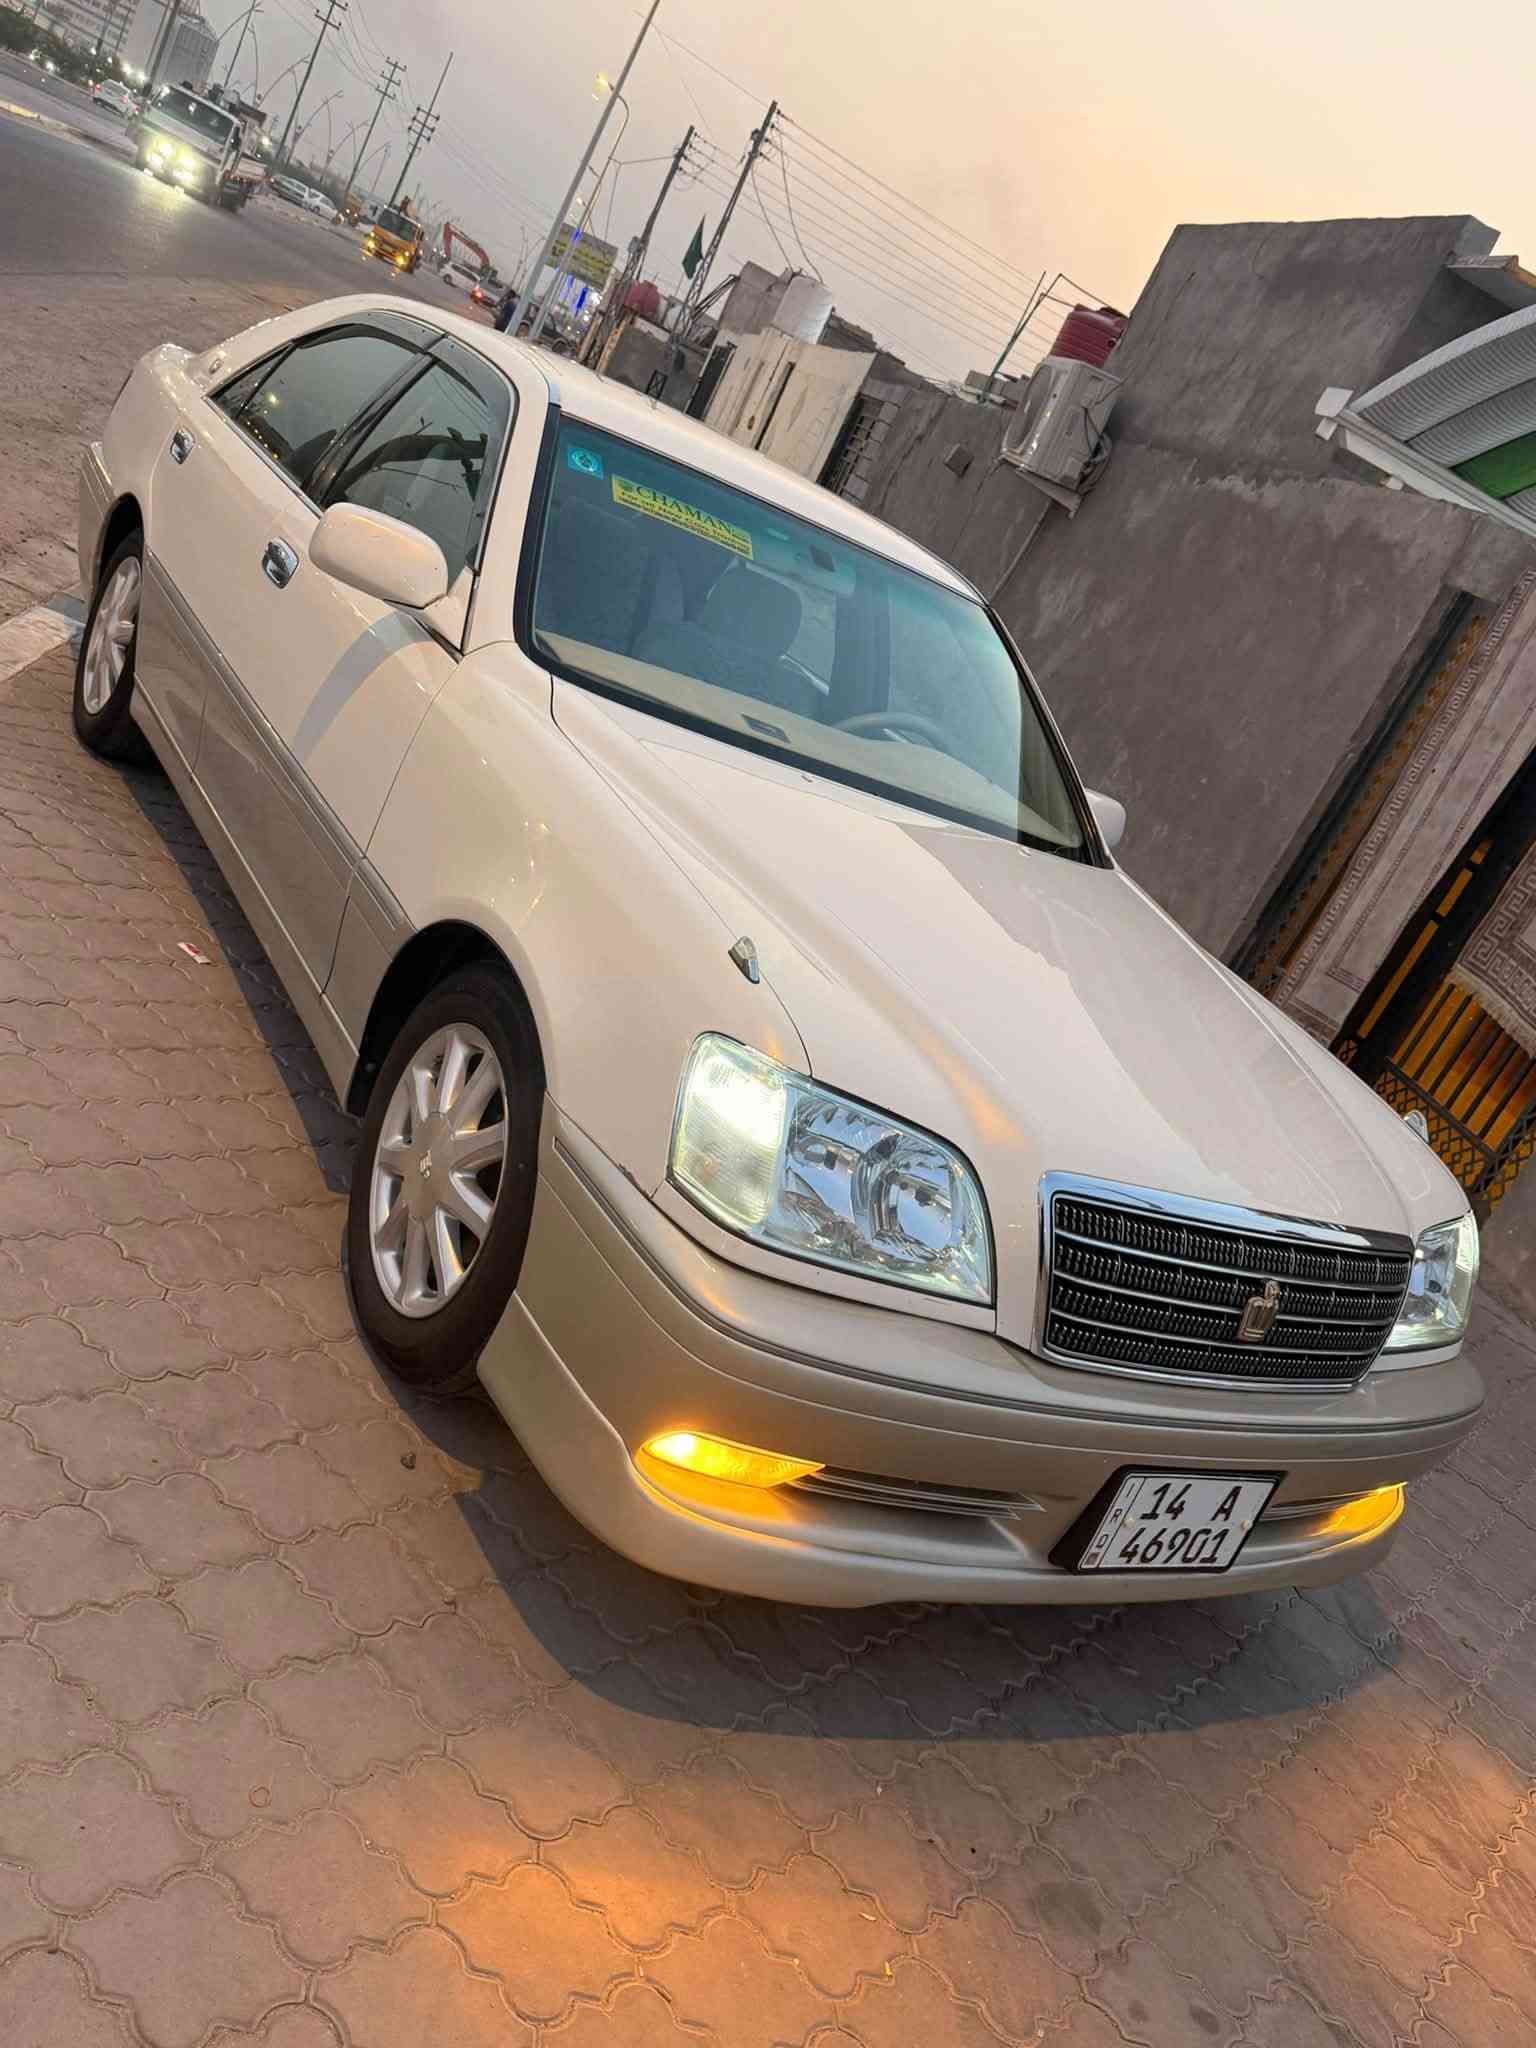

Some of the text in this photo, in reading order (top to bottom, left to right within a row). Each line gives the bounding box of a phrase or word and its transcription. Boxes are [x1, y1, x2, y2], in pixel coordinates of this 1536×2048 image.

[636, 485, 736, 536] CHAMAN
[1139, 1482, 1243, 1521] 14 A
[1118, 1527, 1230, 1564] 46901
